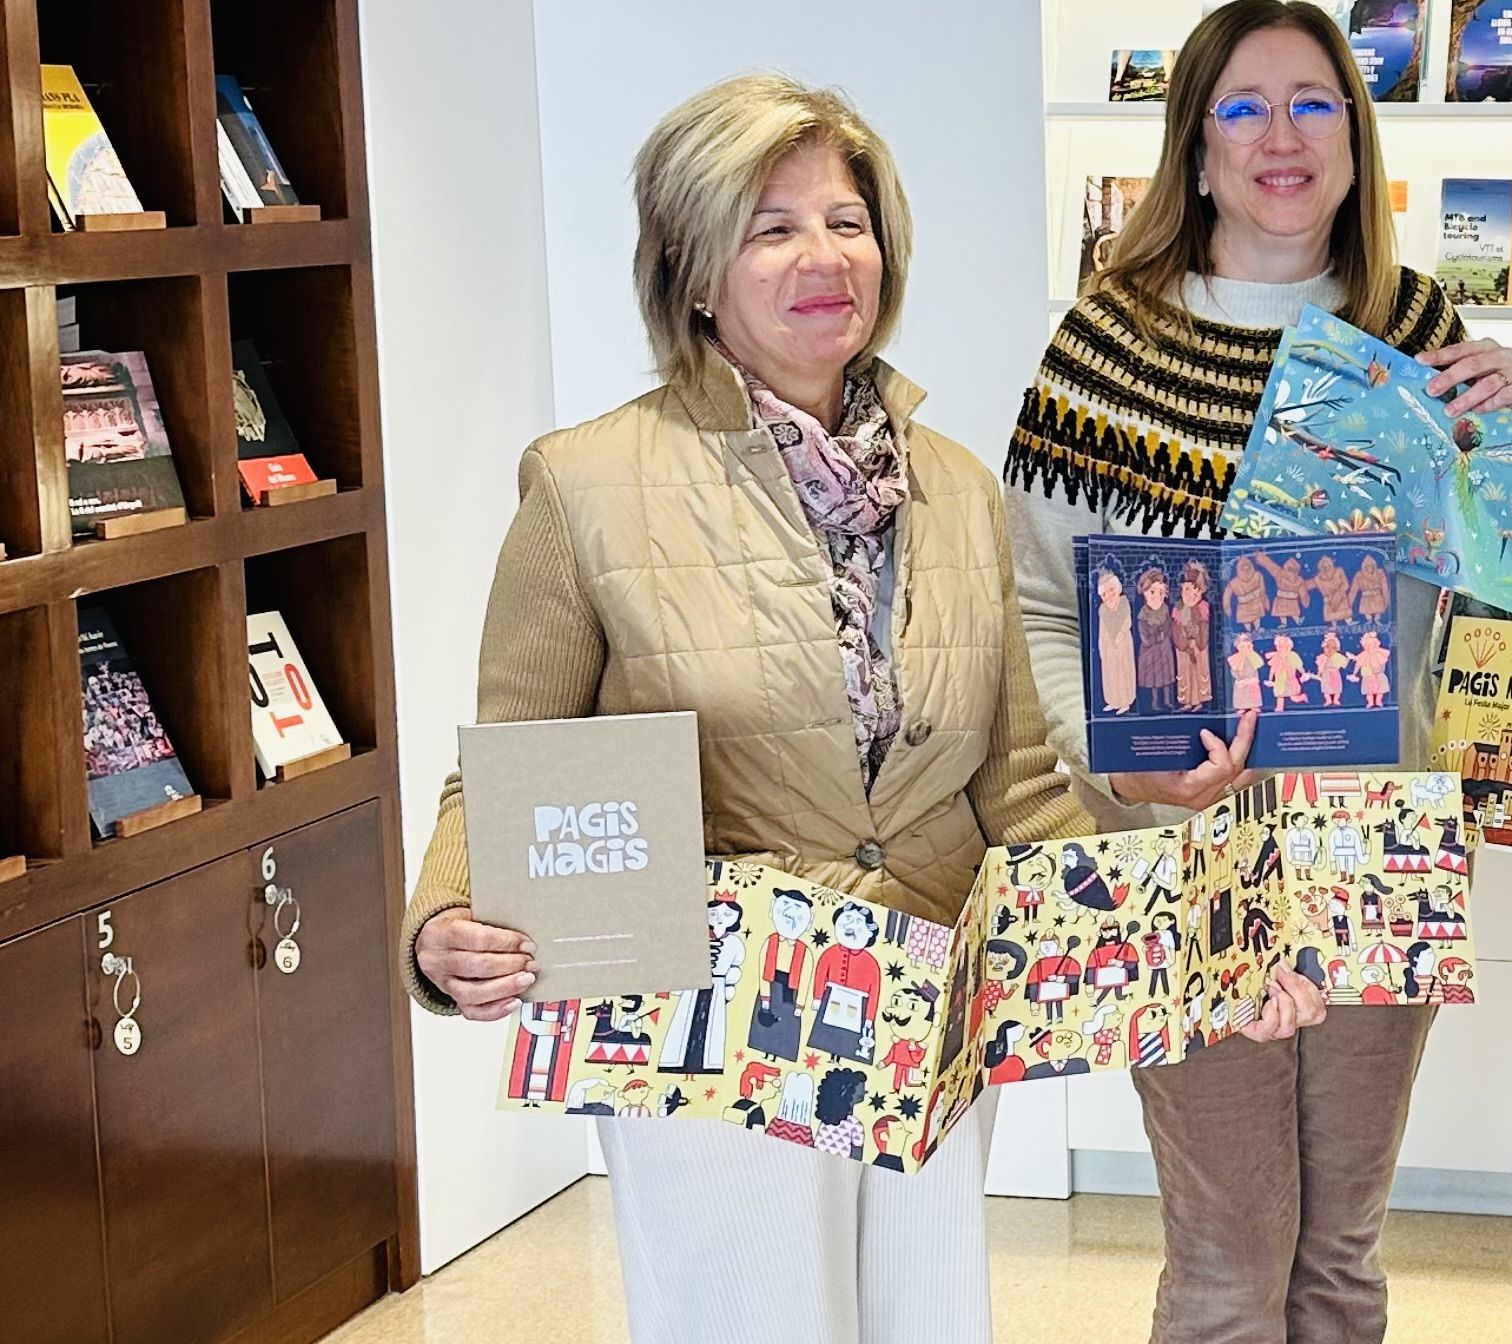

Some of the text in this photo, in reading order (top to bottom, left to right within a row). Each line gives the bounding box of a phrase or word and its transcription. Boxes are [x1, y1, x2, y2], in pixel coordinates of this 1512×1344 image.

[261, 846, 276, 881] 6
[97, 910, 114, 949] 5
[282, 956, 293, 969] 6
[122, 1037, 133, 1050] 5
